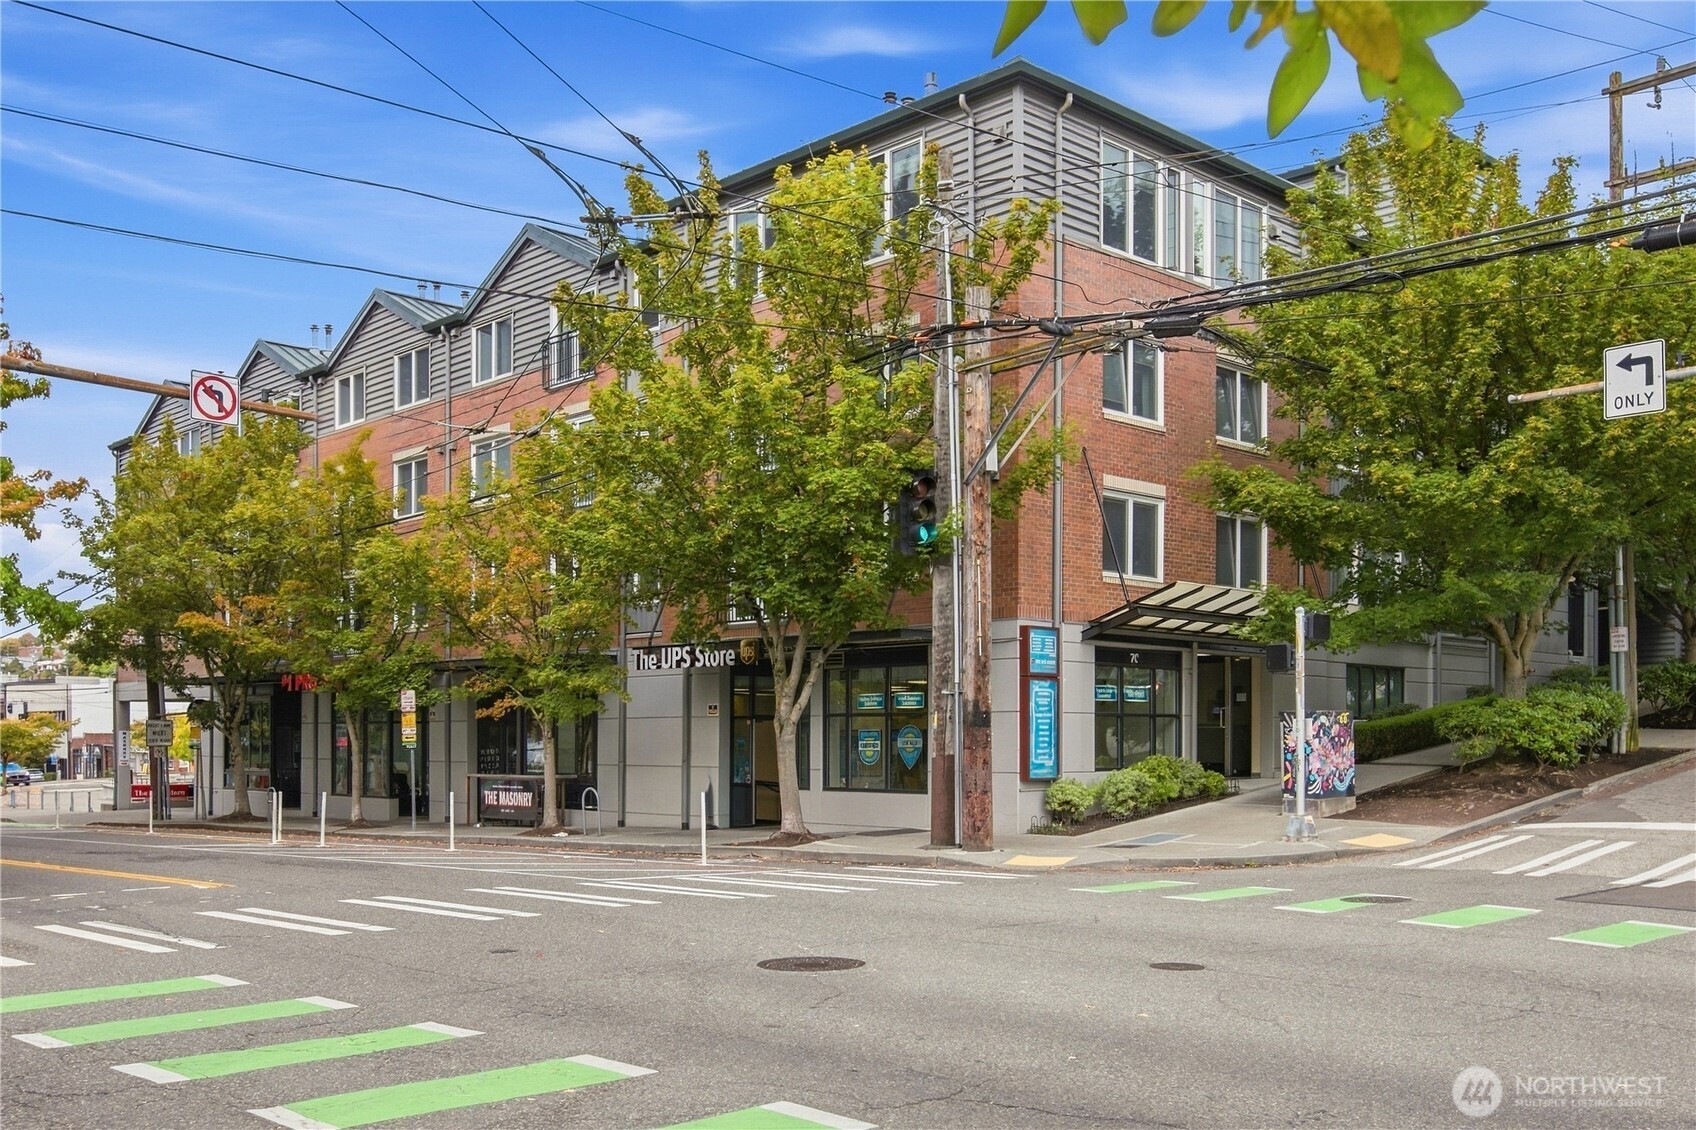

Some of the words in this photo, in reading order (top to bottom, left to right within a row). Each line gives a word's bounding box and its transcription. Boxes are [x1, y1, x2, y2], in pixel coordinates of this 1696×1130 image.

[1614, 391, 1654, 410] ONLY
[632, 649, 658, 671] The
[661, 646, 691, 669] UPS
[695, 646, 736, 668] Store
[740, 646, 755, 661] ups
[484, 790, 498, 805] THE
[499, 791, 533, 807] MASONRY
